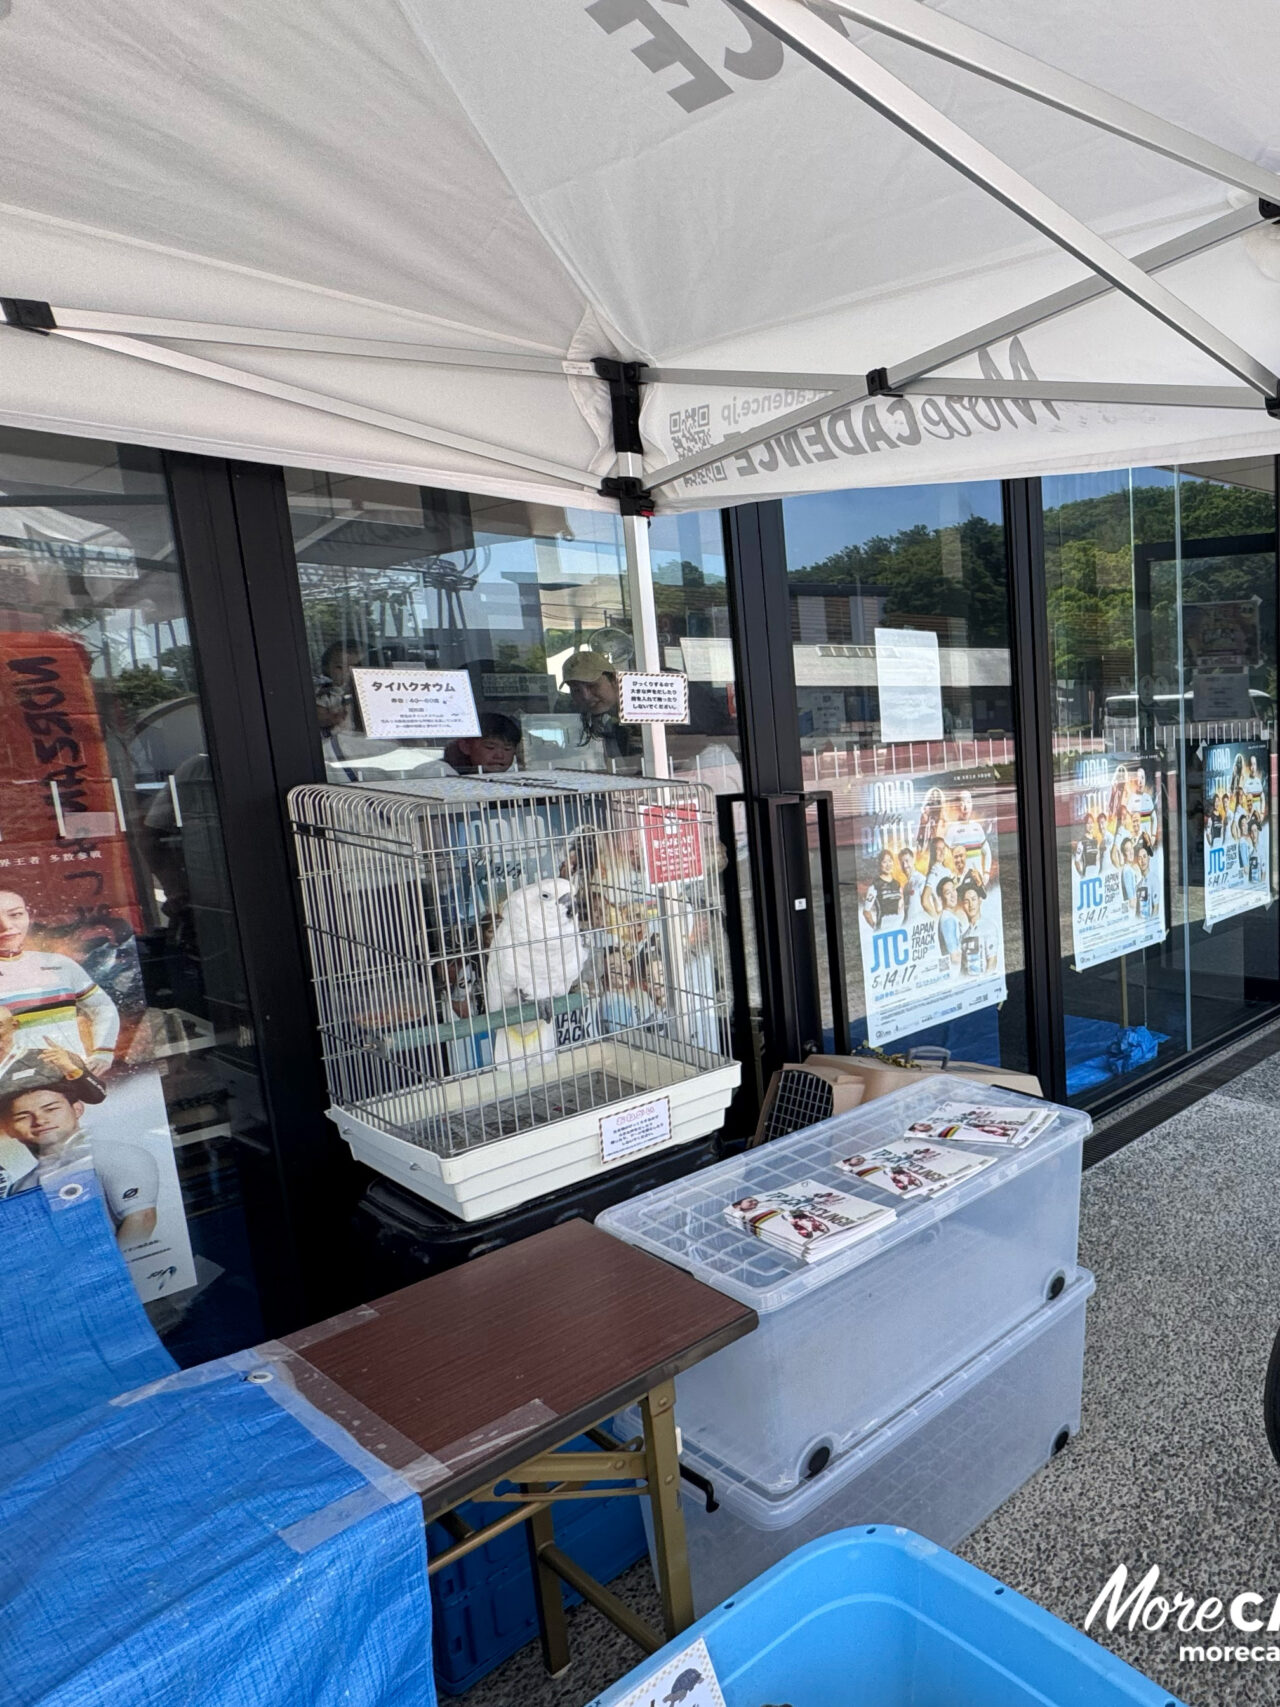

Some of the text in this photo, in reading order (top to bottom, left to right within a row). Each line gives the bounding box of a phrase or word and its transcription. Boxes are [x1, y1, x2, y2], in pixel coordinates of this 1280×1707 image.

[372, 681, 456, 692] タイハクオウム
[1208, 847, 1225, 875] JTC
[1077, 877, 1103, 911] JTC
[912, 920, 935, 938] JAPAN
[911, 933, 935, 949] TRACK
[870, 928, 909, 974] JTC
[911, 947, 928, 962] CUP
